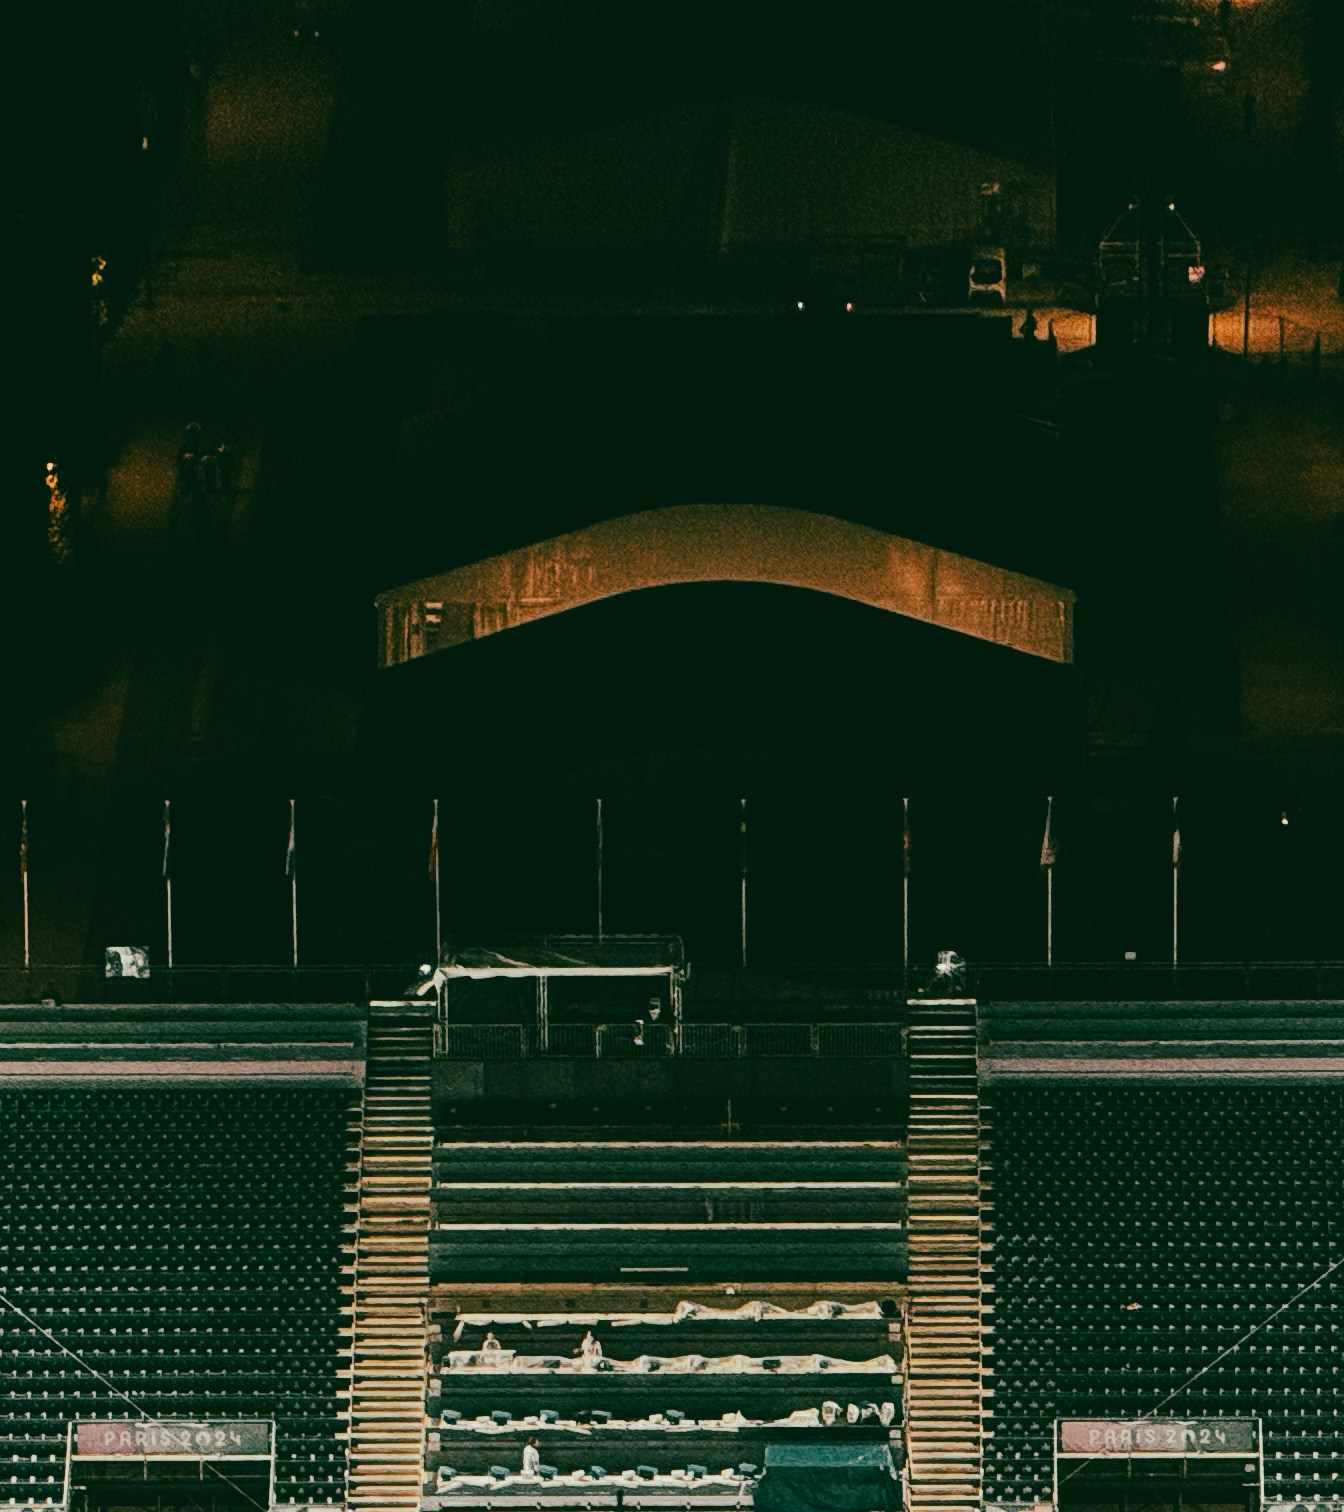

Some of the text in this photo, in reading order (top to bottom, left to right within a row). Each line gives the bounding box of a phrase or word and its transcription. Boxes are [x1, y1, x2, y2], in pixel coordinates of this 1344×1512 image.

[105, 1430, 242, 1447] PARIS 2024
[1088, 1428, 1227, 1446] PARIS 2024
